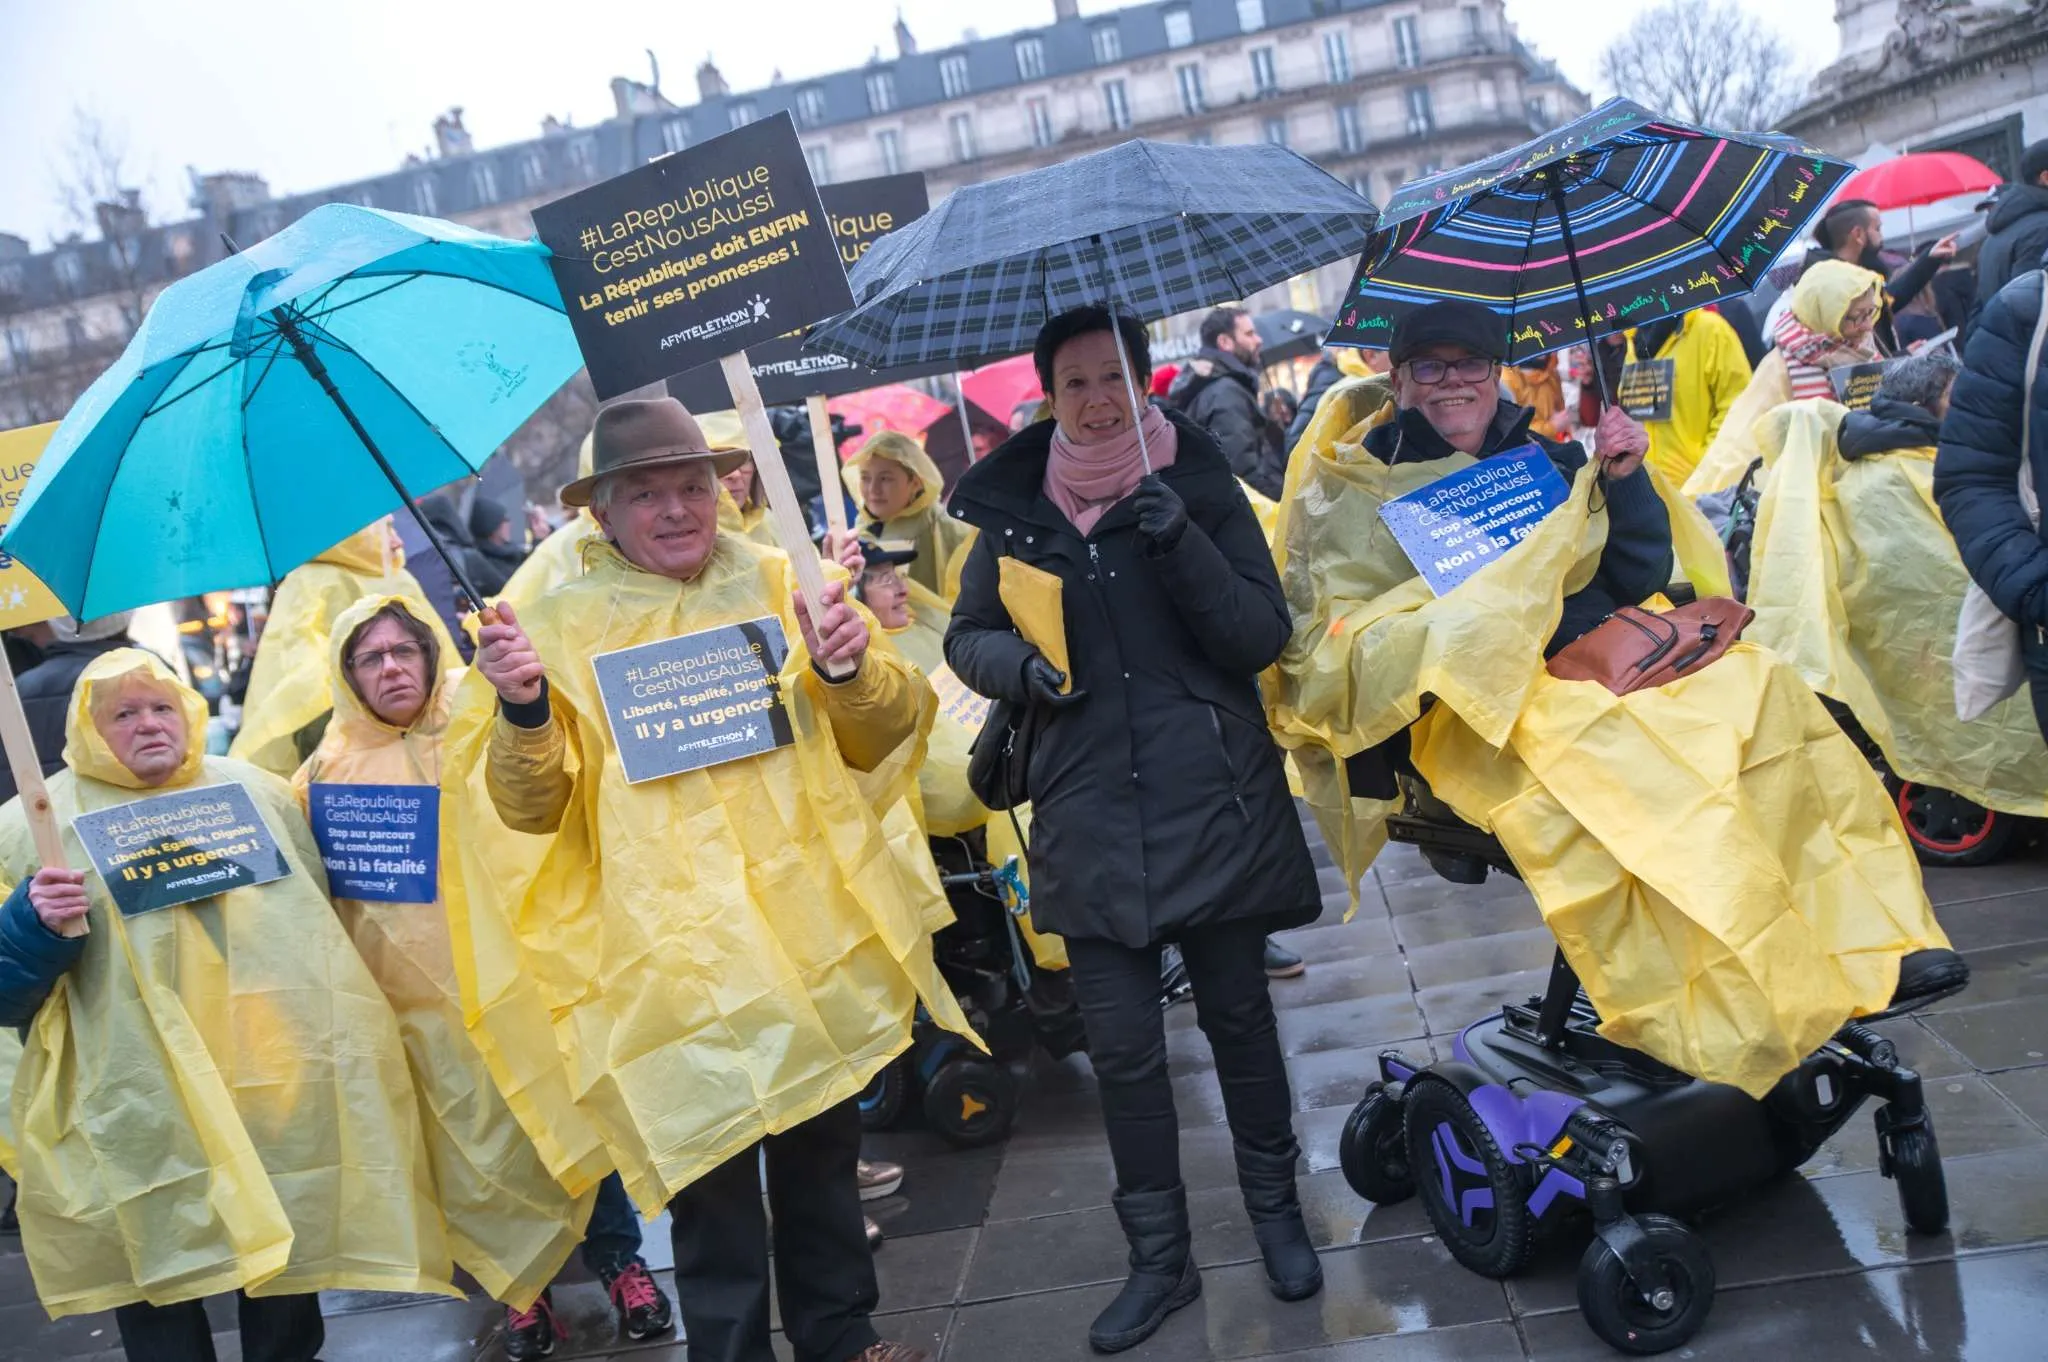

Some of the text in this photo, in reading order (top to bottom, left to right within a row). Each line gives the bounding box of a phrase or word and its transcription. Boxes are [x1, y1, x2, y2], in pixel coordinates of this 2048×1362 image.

[579, 166, 769, 250] #LaRepublique
[593, 187, 775, 273] CestNousAussi
[579, 292, 603, 311] La
[603, 251, 708, 301] République
[711, 235, 748, 261] doit
[749, 210, 809, 245] ENFIN
[604, 240, 801, 326] tenir ses promesses !
[1408, 460, 1528, 515] #LaRepublique
[1419, 471, 1534, 526] CestNousAussi
[1430, 488, 1542, 540] Stop aux parcours
[1445, 532, 1463, 548] du
[1465, 504, 1538, 539] combattant
[1537, 500, 1545, 510] !
[1434, 535, 1510, 574] Non à la
[625, 643, 762, 683] #LaRepublique
[633, 656, 764, 698] CestNousAussi
[622, 674, 778, 720] Liberté, Egalité, Dignit
[634, 722, 650, 739] Il
[653, 721, 667, 739] y
[672, 718, 685, 731] a
[689, 698, 773, 726] urgence
[107, 802, 231, 835] #LaRepublique
[324, 794, 421, 811] #LaRepublique
[326, 809, 417, 824] CestNousAussi
[107, 845, 161, 866] Liberté,
[213, 824, 256, 841] Dignité
[115, 815, 234, 847] CestNousAussi
[328, 827, 416, 841] Stop aux parcours
[332, 842, 345, 851] du
[346, 843, 404, 854] combattant
[121, 839, 261, 881] Il y a urgence !
[348, 858, 357, 872] à
[359, 858, 372, 872] la
[373, 858, 427, 874] fatalité
